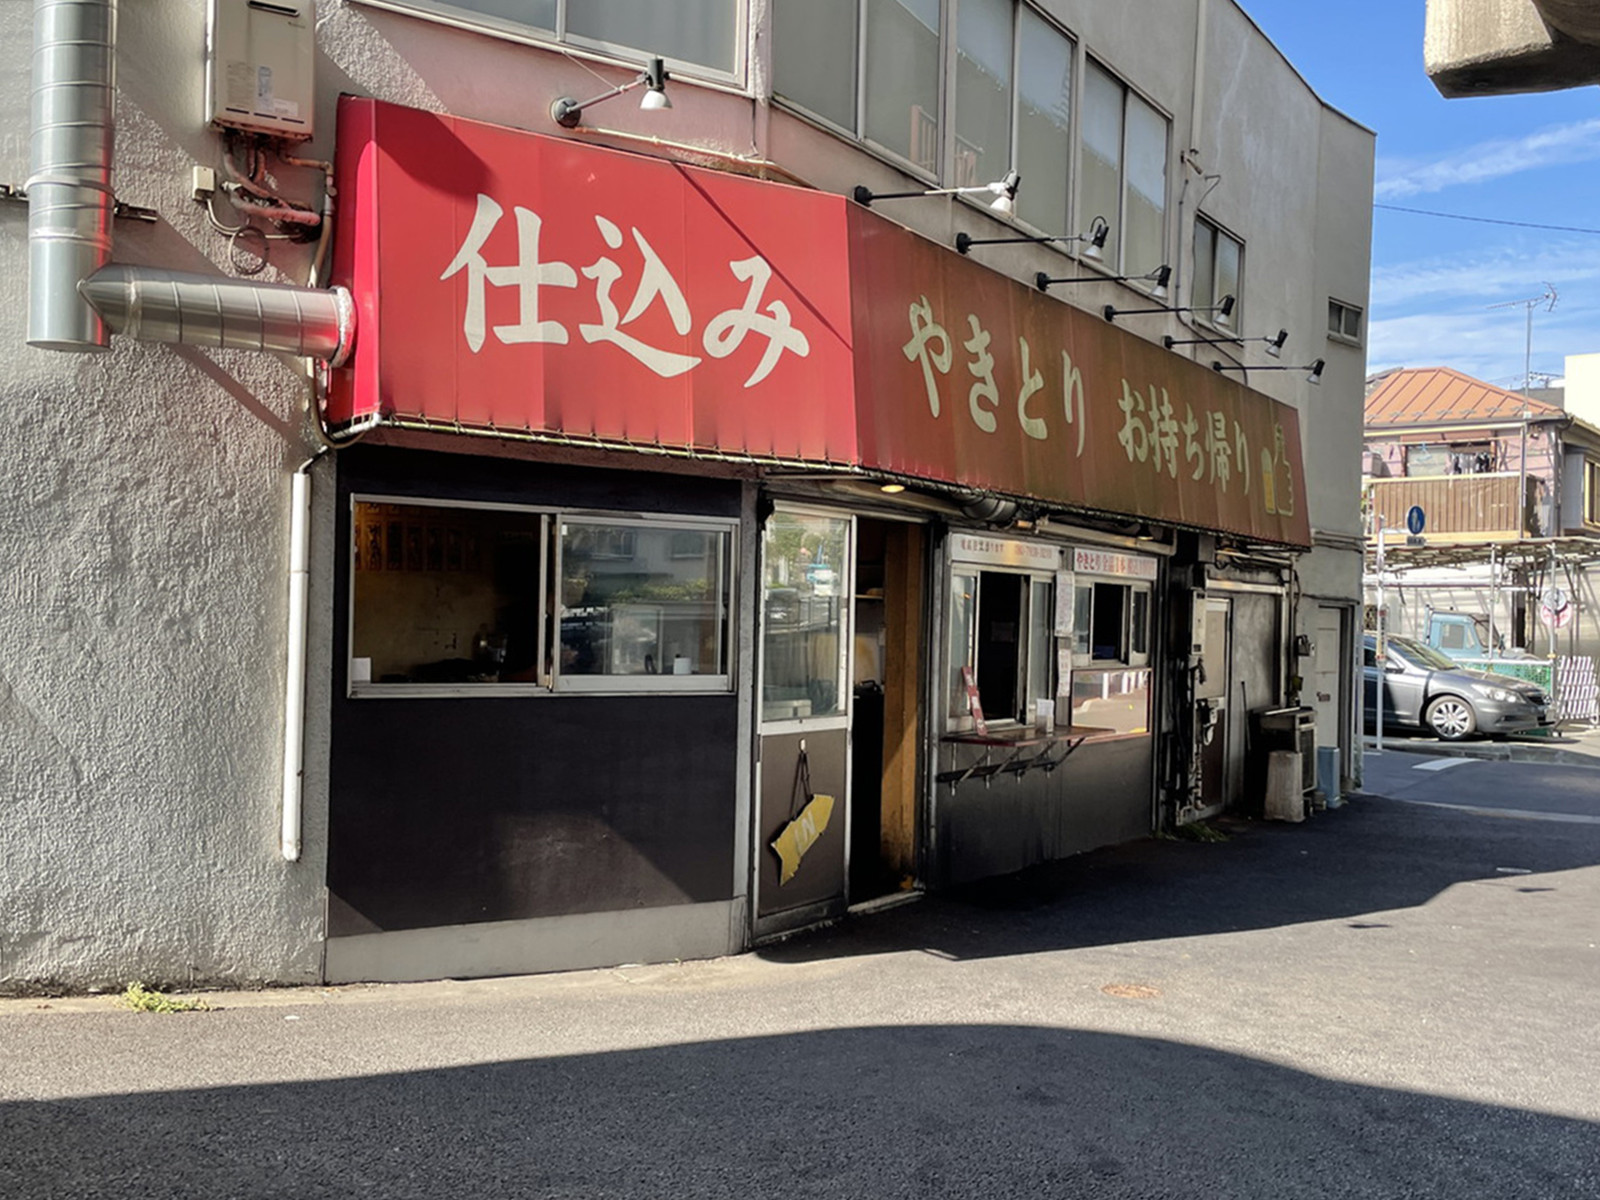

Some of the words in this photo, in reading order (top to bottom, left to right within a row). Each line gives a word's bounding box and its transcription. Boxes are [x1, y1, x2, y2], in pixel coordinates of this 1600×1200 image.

[441, 193, 810, 388] 仕込み
[903, 296, 1086, 456] やきとり
[1117, 379, 1251, 496] お持ち帰り
